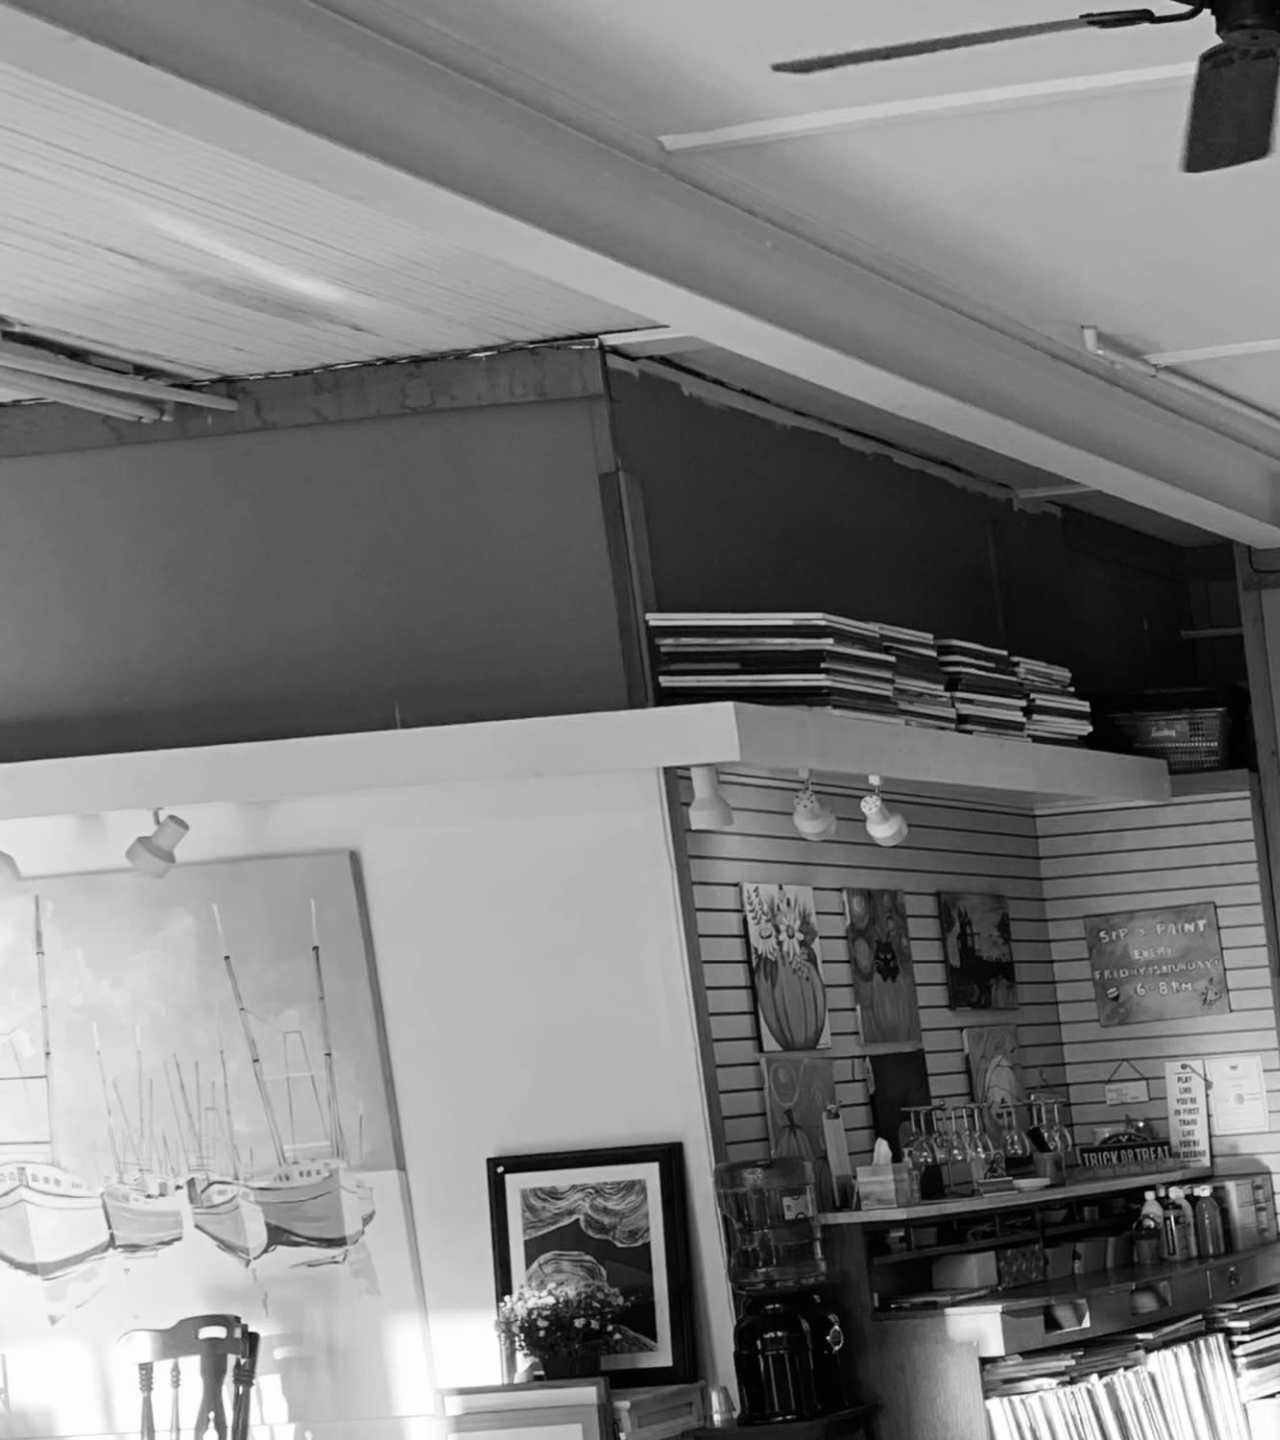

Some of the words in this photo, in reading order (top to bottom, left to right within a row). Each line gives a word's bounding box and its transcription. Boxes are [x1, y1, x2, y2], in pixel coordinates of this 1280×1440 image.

[1082, 1151, 1118, 1168] TRICK
[1120, 1149, 1134, 1162] OR
[1134, 1146, 1171, 1161] TREAT
